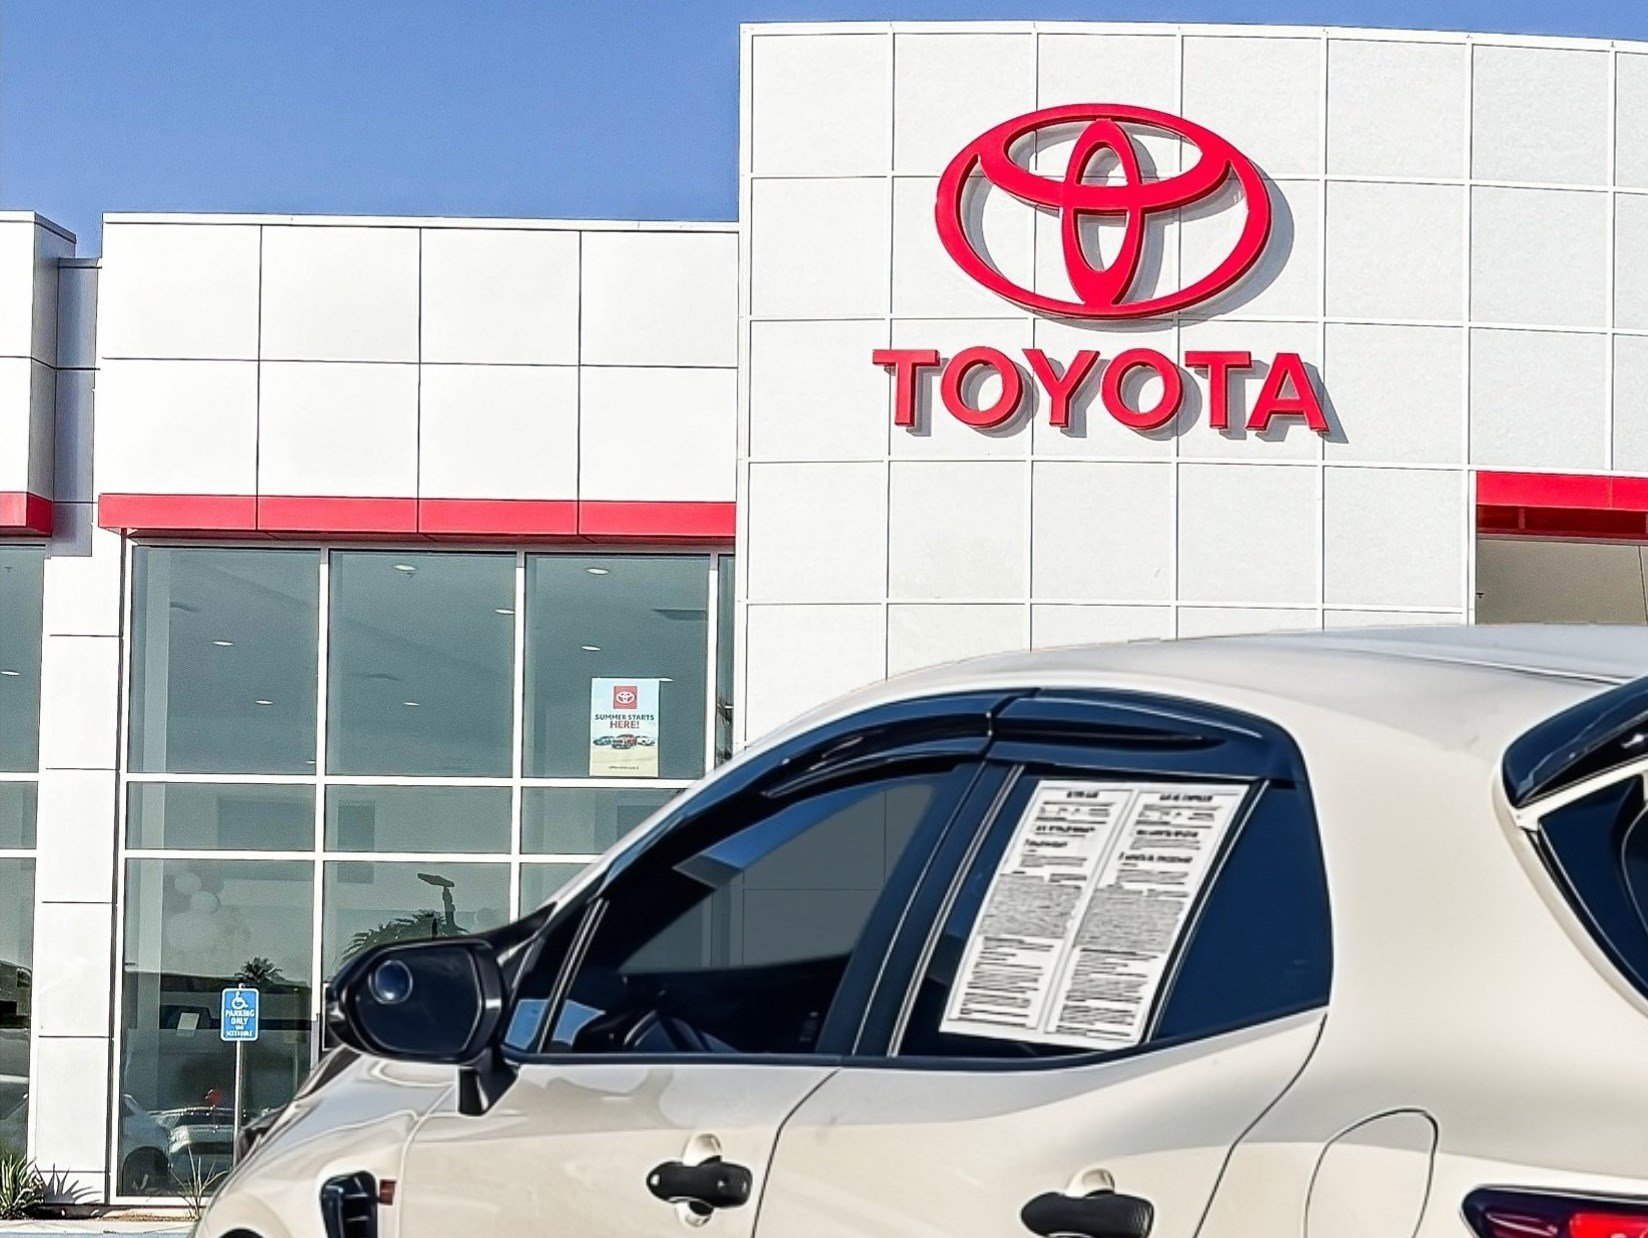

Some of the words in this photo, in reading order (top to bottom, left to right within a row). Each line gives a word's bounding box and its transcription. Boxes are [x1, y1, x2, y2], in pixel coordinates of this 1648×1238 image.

[872, 345, 1328, 434] TOYOTA
[610, 721, 640, 729] HERE!
[225, 1009, 255, 1018] PARKING
[230, 1016, 249, 1025] ONLY
